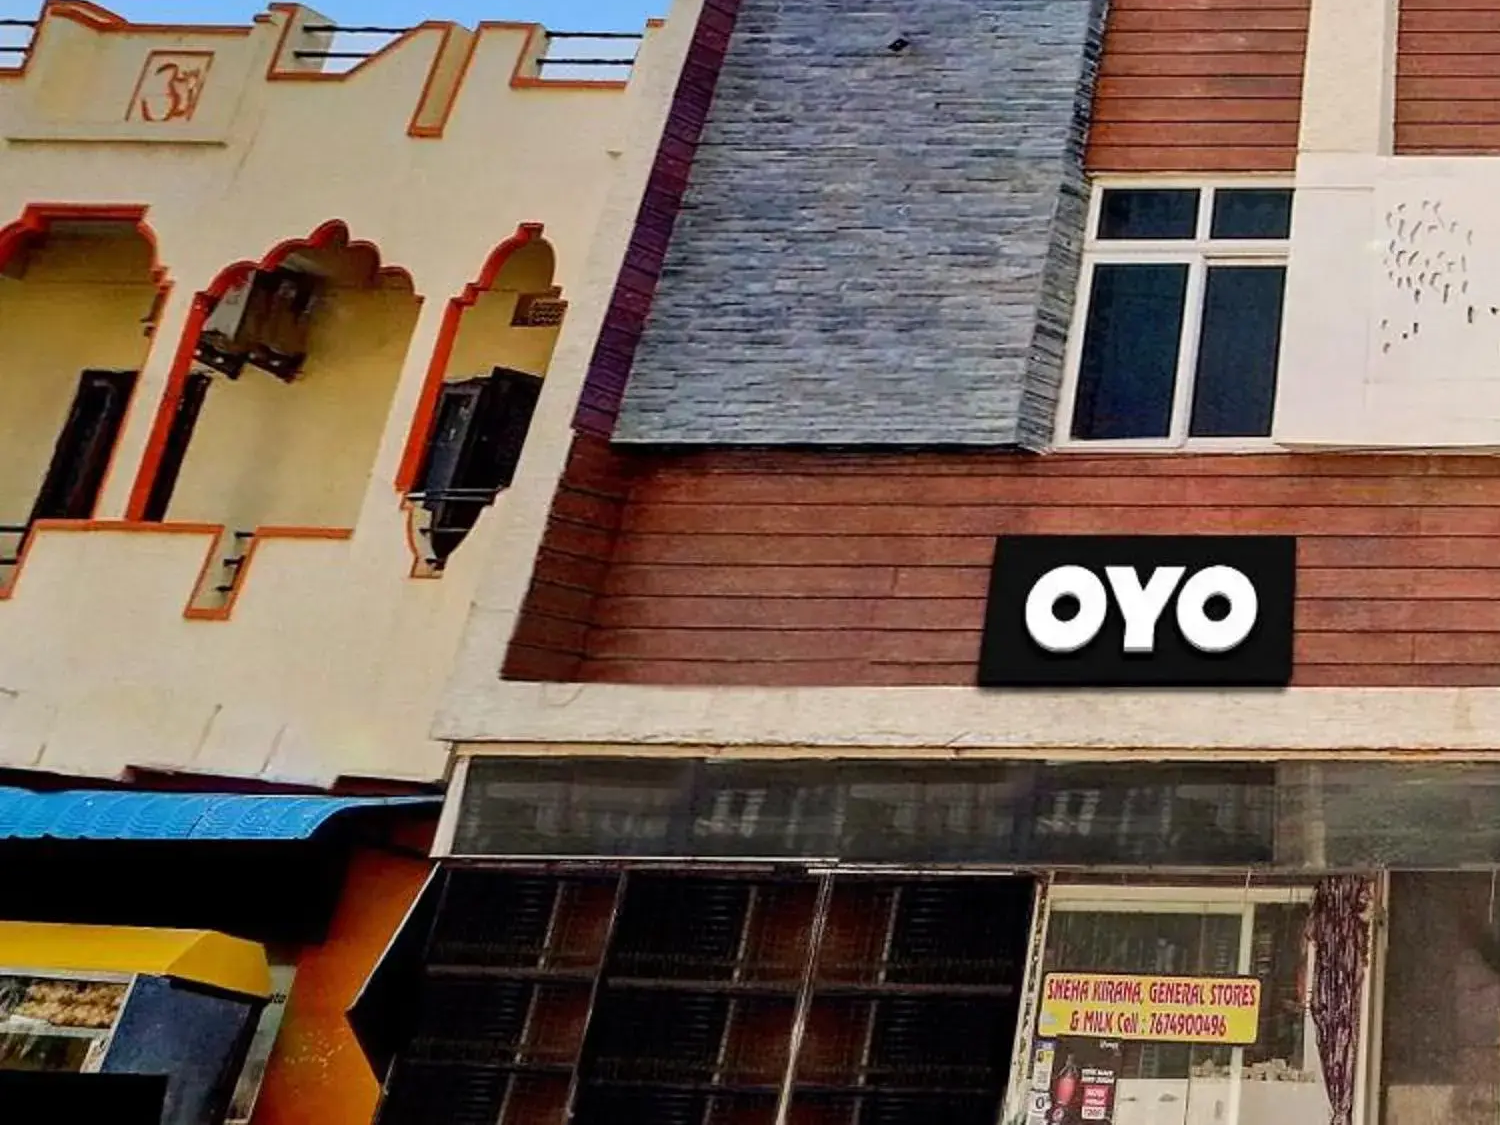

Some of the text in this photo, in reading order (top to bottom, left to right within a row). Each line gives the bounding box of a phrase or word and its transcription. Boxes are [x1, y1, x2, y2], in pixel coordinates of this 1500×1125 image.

[1025, 564, 1258, 653] OYO
[1047, 978, 1089, 1003] SNEHA
[1149, 982, 1206, 1006] GENERAL
[1210, 984, 1256, 1008] STORES
[1069, 1010, 1079, 1032] &
[1083, 1011, 1113, 1034] MILK
[1117, 1012, 1139, 1034] Cell
[1149, 1013, 1227, 1037] 7674900496
